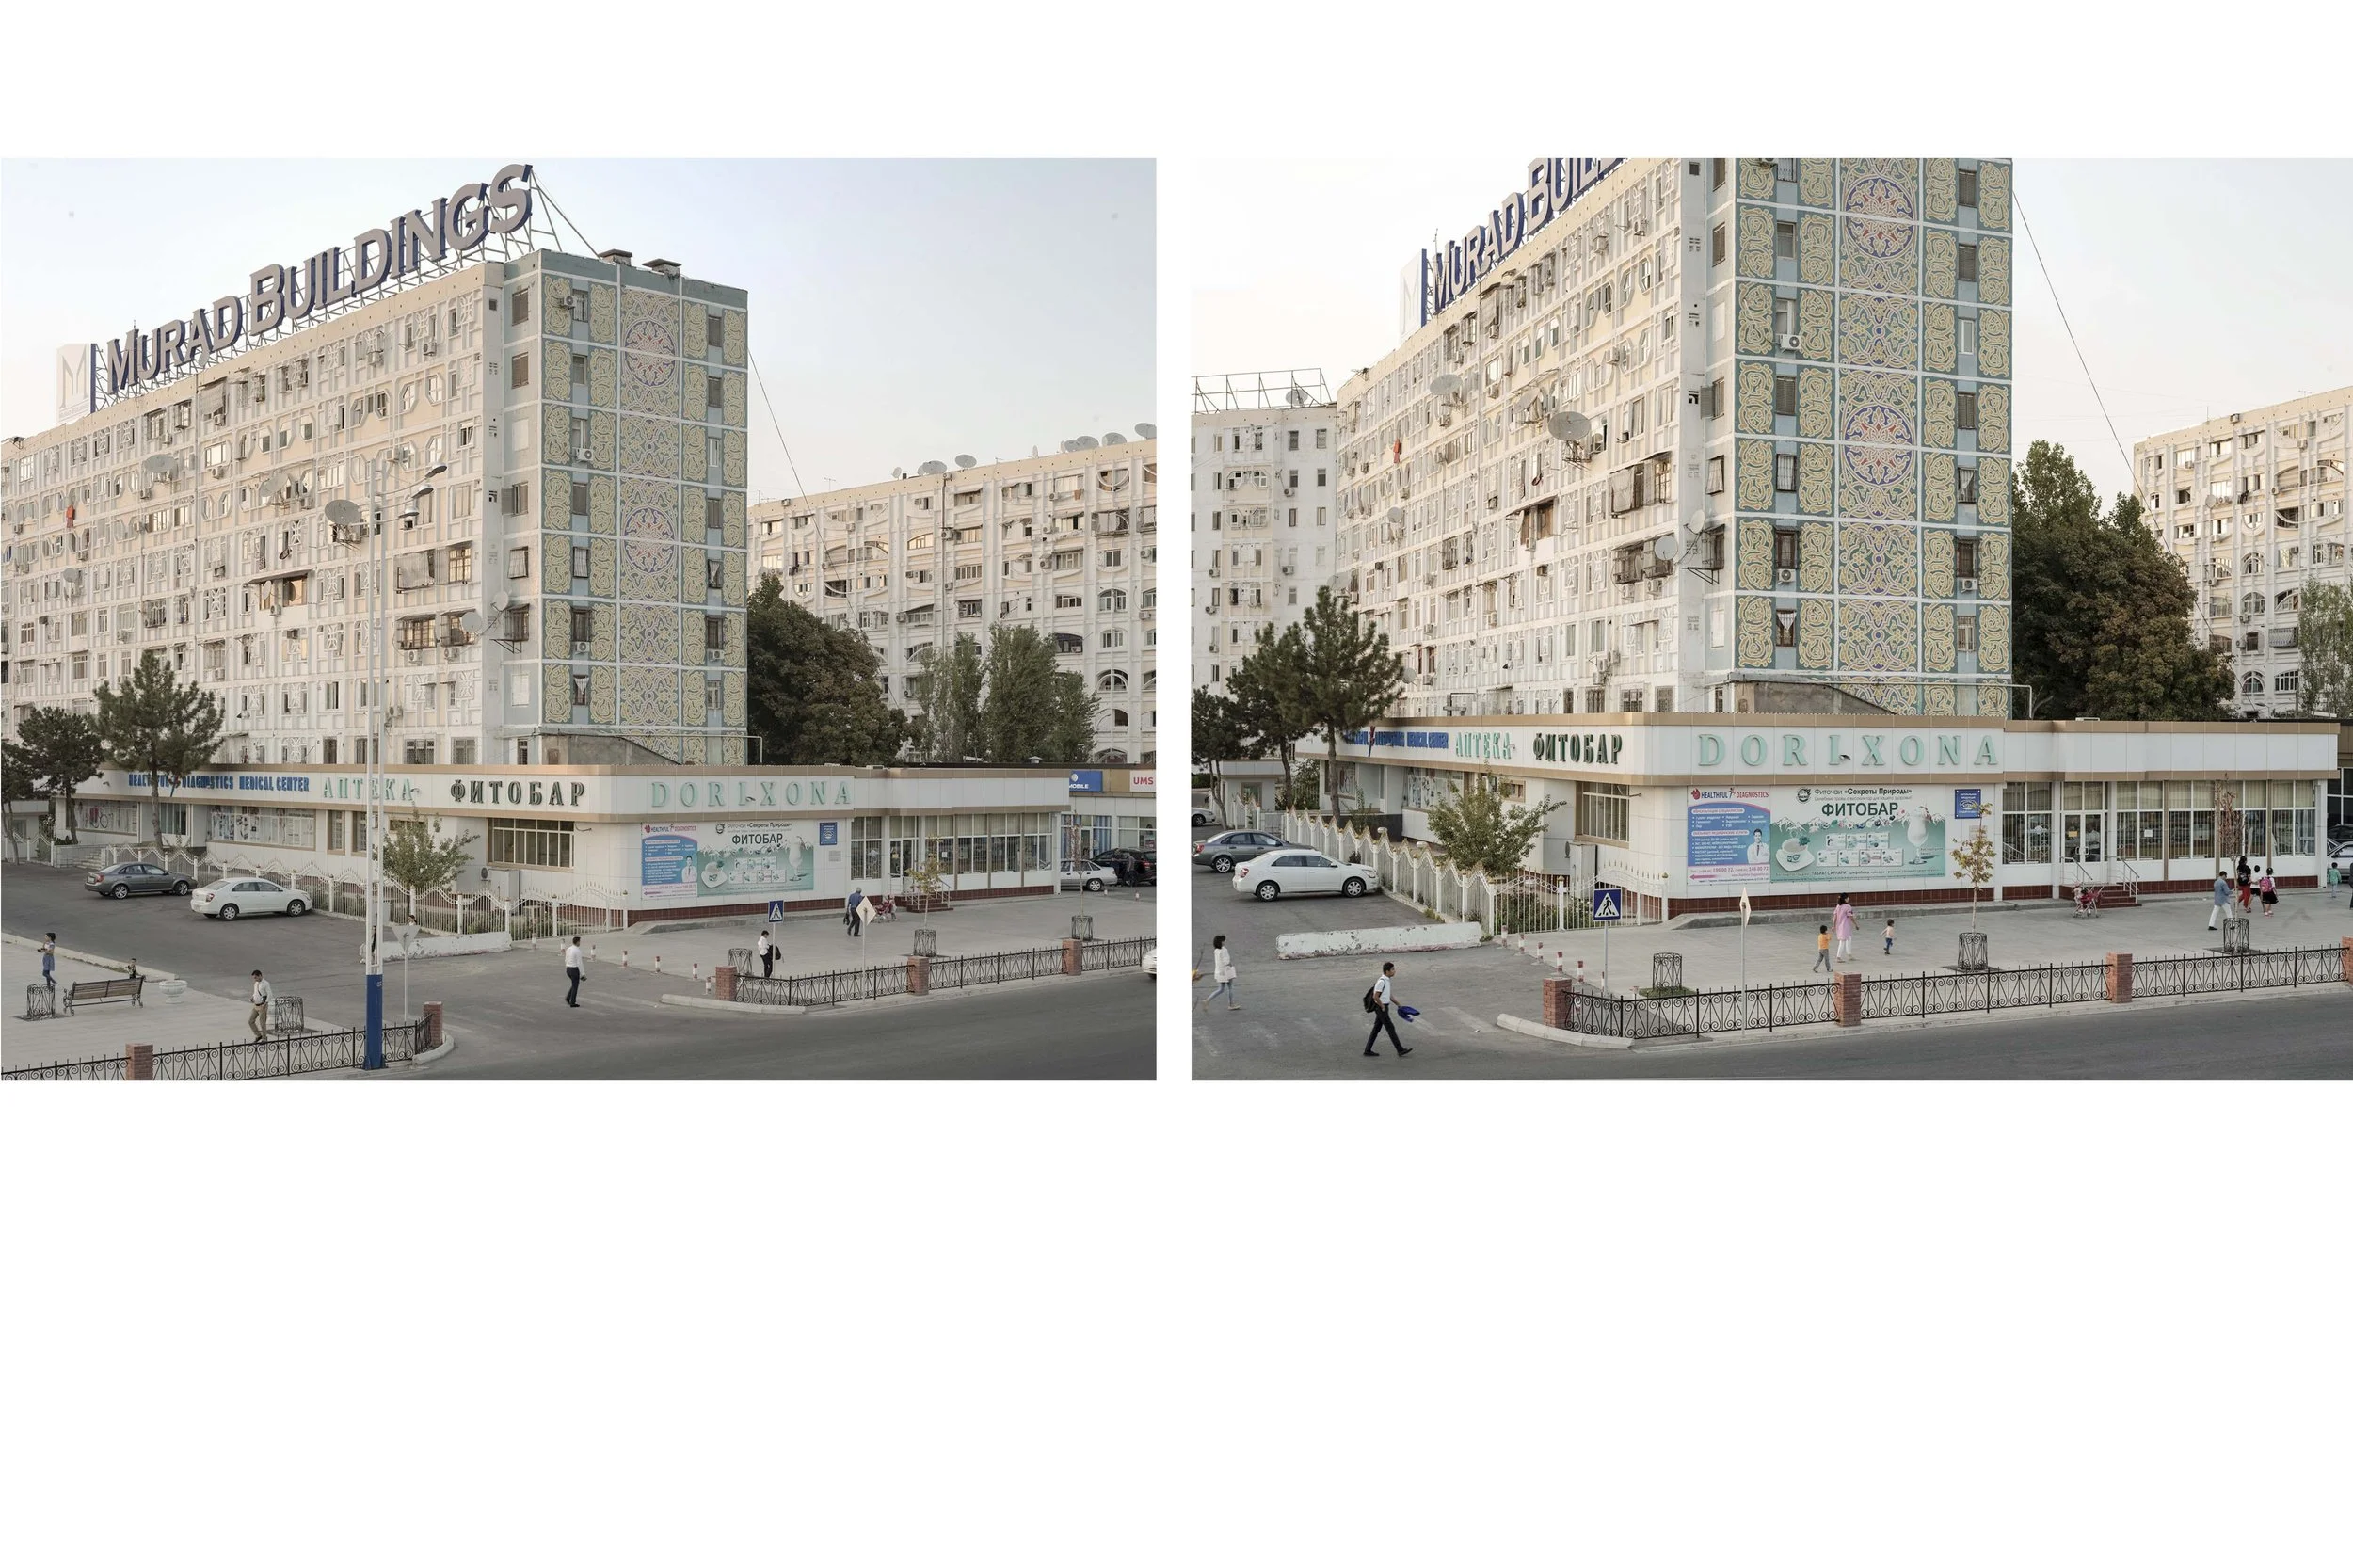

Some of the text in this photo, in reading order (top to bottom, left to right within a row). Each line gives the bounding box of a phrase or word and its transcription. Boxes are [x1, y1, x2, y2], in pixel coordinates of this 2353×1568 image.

[1432, 157, 1628, 316] MURAD BUIL
[106, 164, 534, 395] MURAD BUILDINGS
[1455, 731, 1512, 760] АПТЕКА
[1532, 732, 1623, 765] ФИТОБАР
[1698, 733, 1999, 766] DORIXONA
[128, 774, 169, 787] HEALTFUL
[239, 776, 274, 792] MEDICAL
[276, 776, 310, 792] CENTER
[323, 776, 414, 801] АПТЕКА
[450, 779, 585, 807] ФИТОБАР
[1133, 776, 1154, 785] UMS
[650, 781, 852, 808] DORIXONA
[1821, 802, 1898, 816] ФИТОБАР
[731, 833, 783, 845] ФИТОБАР
